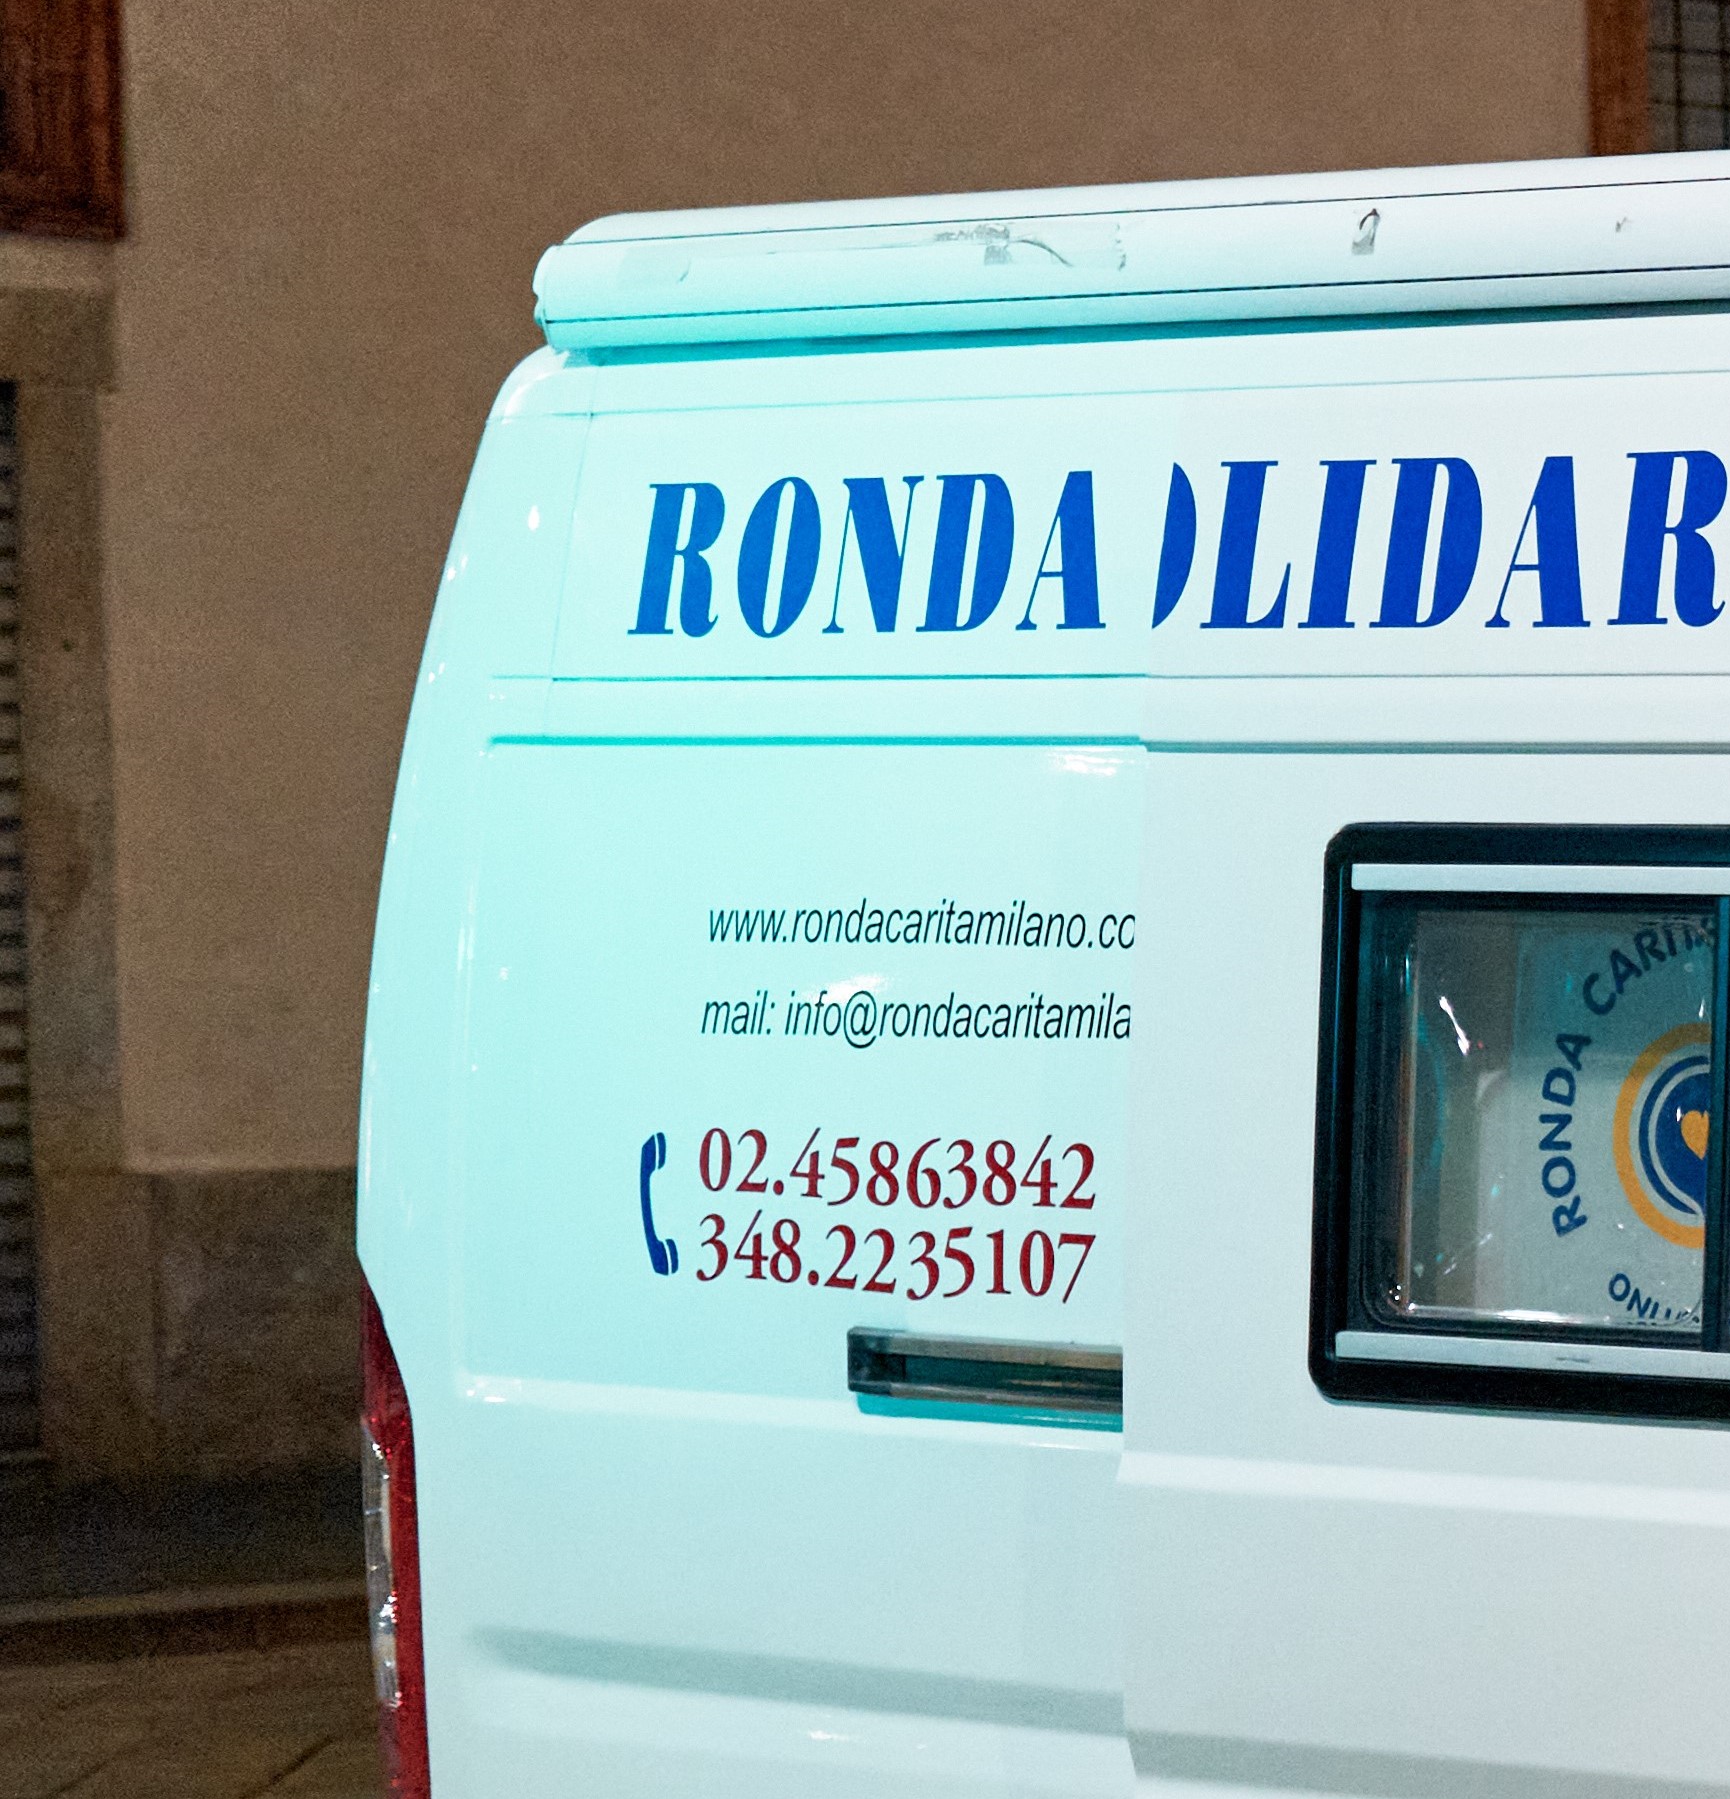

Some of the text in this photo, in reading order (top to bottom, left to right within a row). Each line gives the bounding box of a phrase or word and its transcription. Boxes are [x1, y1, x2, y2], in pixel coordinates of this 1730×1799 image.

[626, 474, 1106, 639] RONDA
[701, 990, 773, 1036] mail:
[699, 1127, 1097, 1210] 02.45863842
[1537, 1031, 1595, 1238] RONDA
[696, 1209, 1097, 1304] 348.2235107
